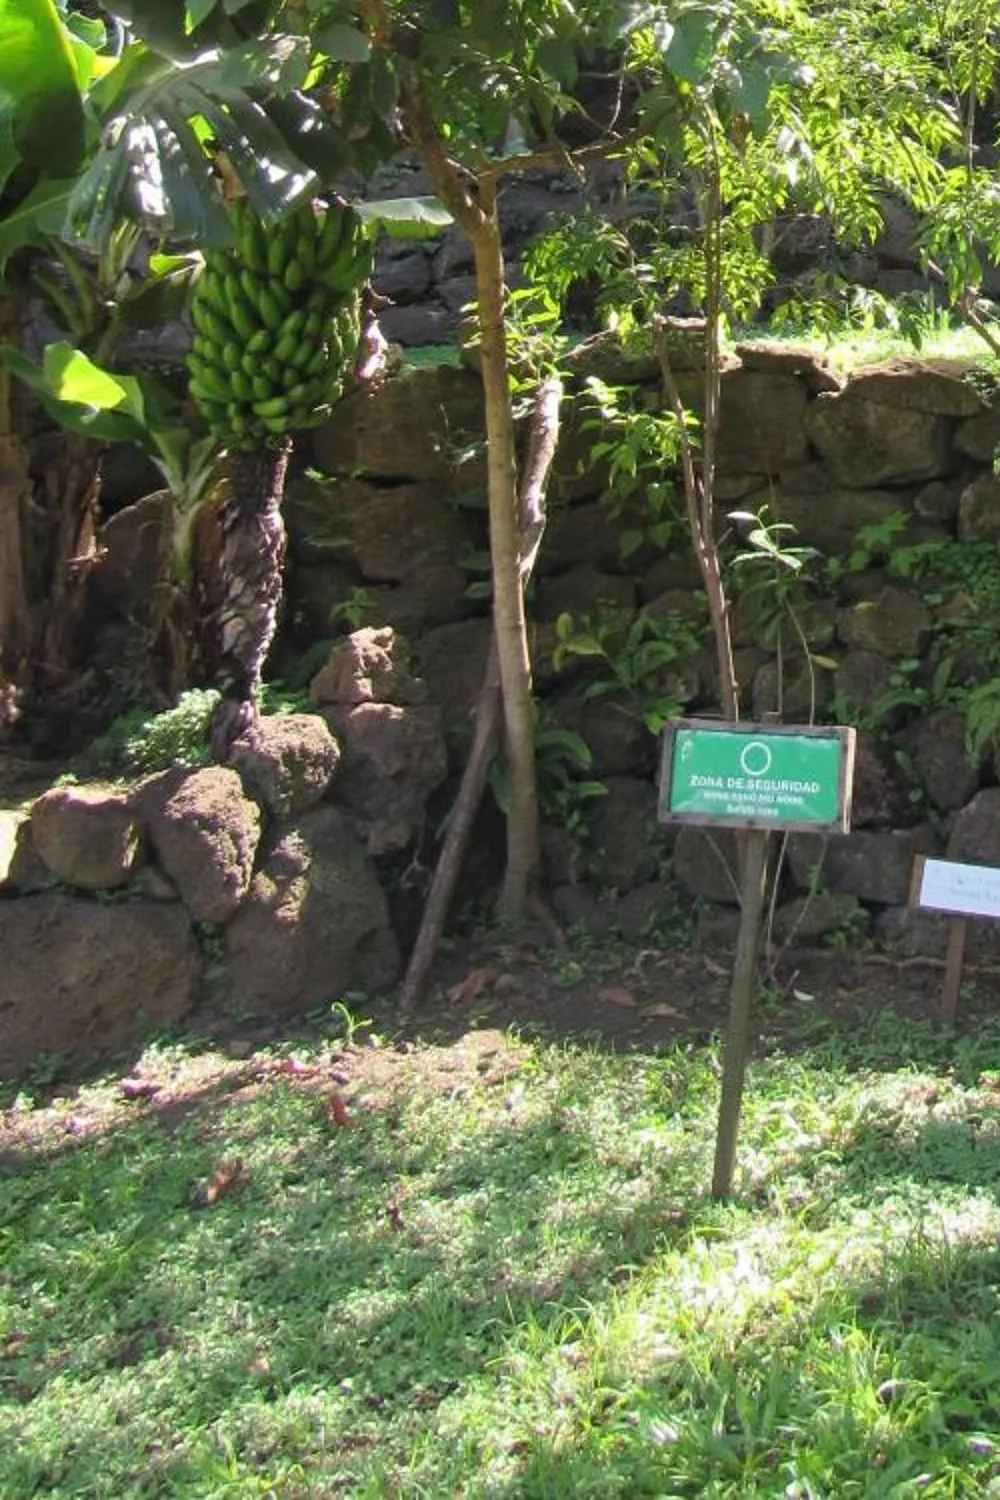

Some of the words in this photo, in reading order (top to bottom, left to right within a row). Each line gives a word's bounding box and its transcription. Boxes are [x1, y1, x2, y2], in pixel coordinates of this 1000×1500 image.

[689, 775, 723, 788] ZONA
[727, 777, 745, 789] DE
[747, 779, 821, 793] SEGURIDAD
